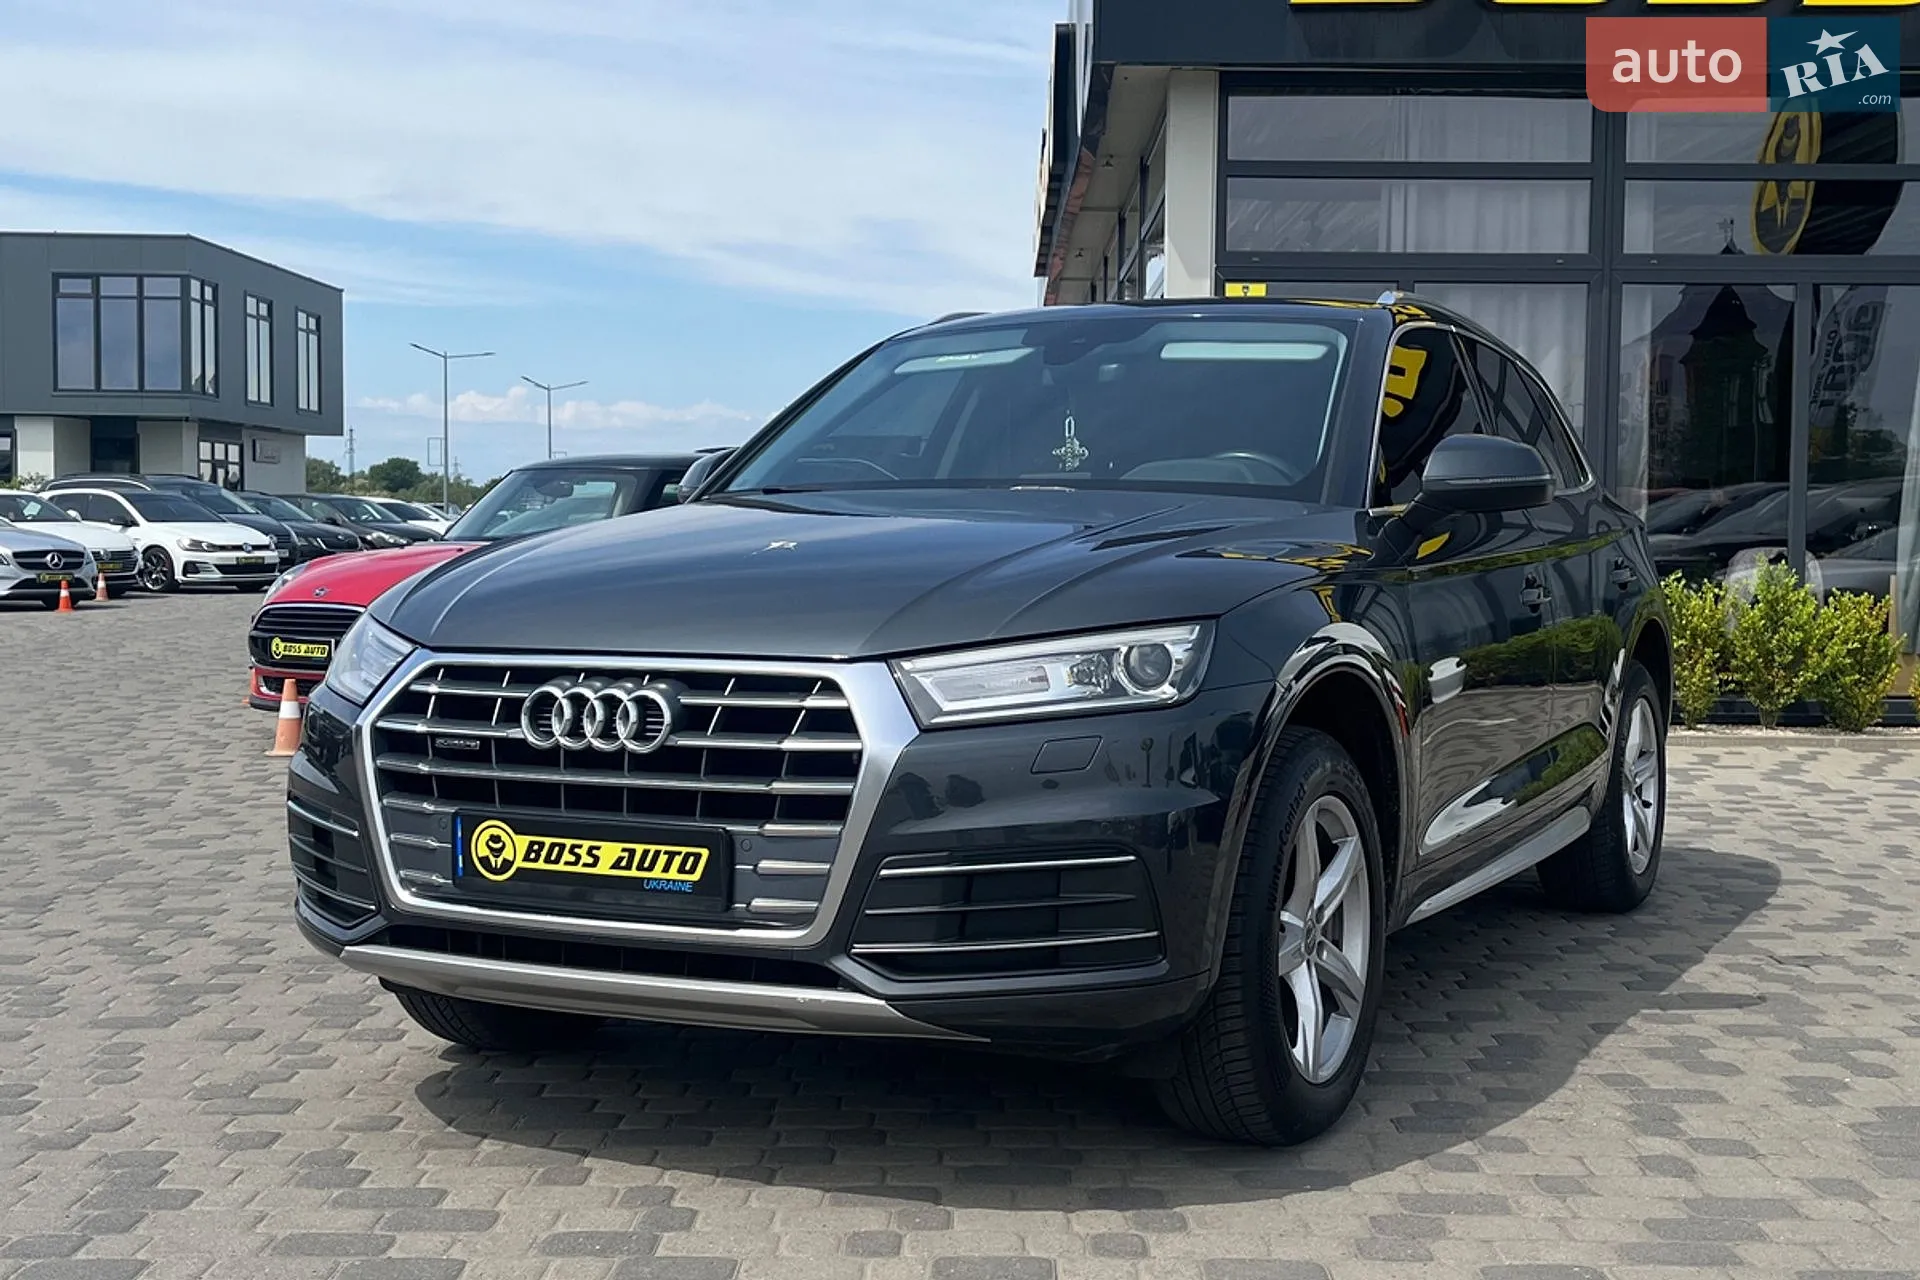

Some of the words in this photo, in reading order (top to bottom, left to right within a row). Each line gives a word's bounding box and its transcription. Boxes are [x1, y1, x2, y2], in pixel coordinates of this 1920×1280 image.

[282, 644, 302, 654] BOSS
[303, 646, 326, 655] AUTO
[522, 840, 602, 868] BOSS
[609, 847, 703, 875] AUTO
[643, 879, 694, 892] UKRAINE
